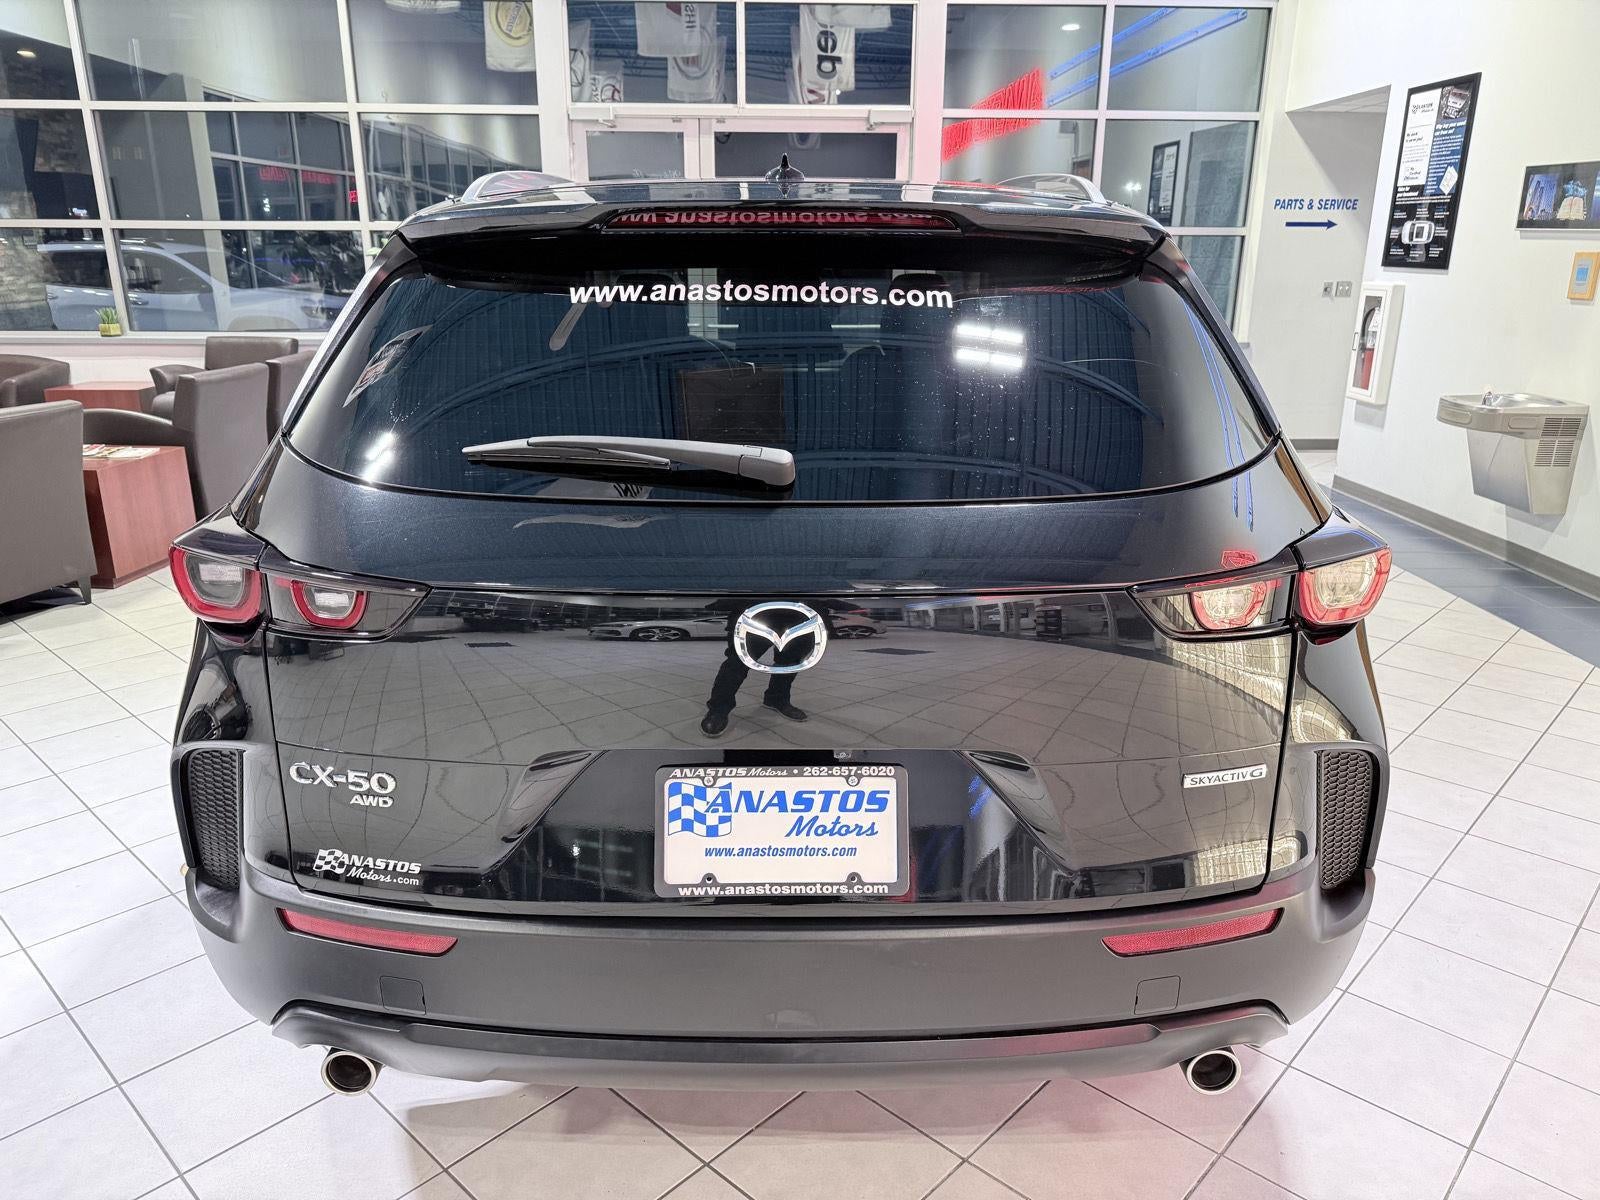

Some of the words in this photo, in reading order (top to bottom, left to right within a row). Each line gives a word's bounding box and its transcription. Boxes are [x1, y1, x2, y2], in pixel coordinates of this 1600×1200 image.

[1274, 199, 1304, 210] PARTS
[1307, 199, 1314, 210] &
[1317, 199, 1358, 210] SERVICE
[569, 279, 953, 309] www.anastosmotors.com
[289, 762, 397, 794] CX-50
[669, 767, 747, 778] ANASTOS
[748, 768, 788, 776] Motors
[803, 767, 895, 776] 262-657-6020
[350, 795, 394, 808] AWD
[706, 790, 890, 813] ANASTOS
[785, 816, 878, 838] Motors
[704, 845, 857, 857] www.anastosmotors.com
[337, 853, 422, 874] ANASTOS
[678, 884, 889, 896] www.anastosmotors.com
